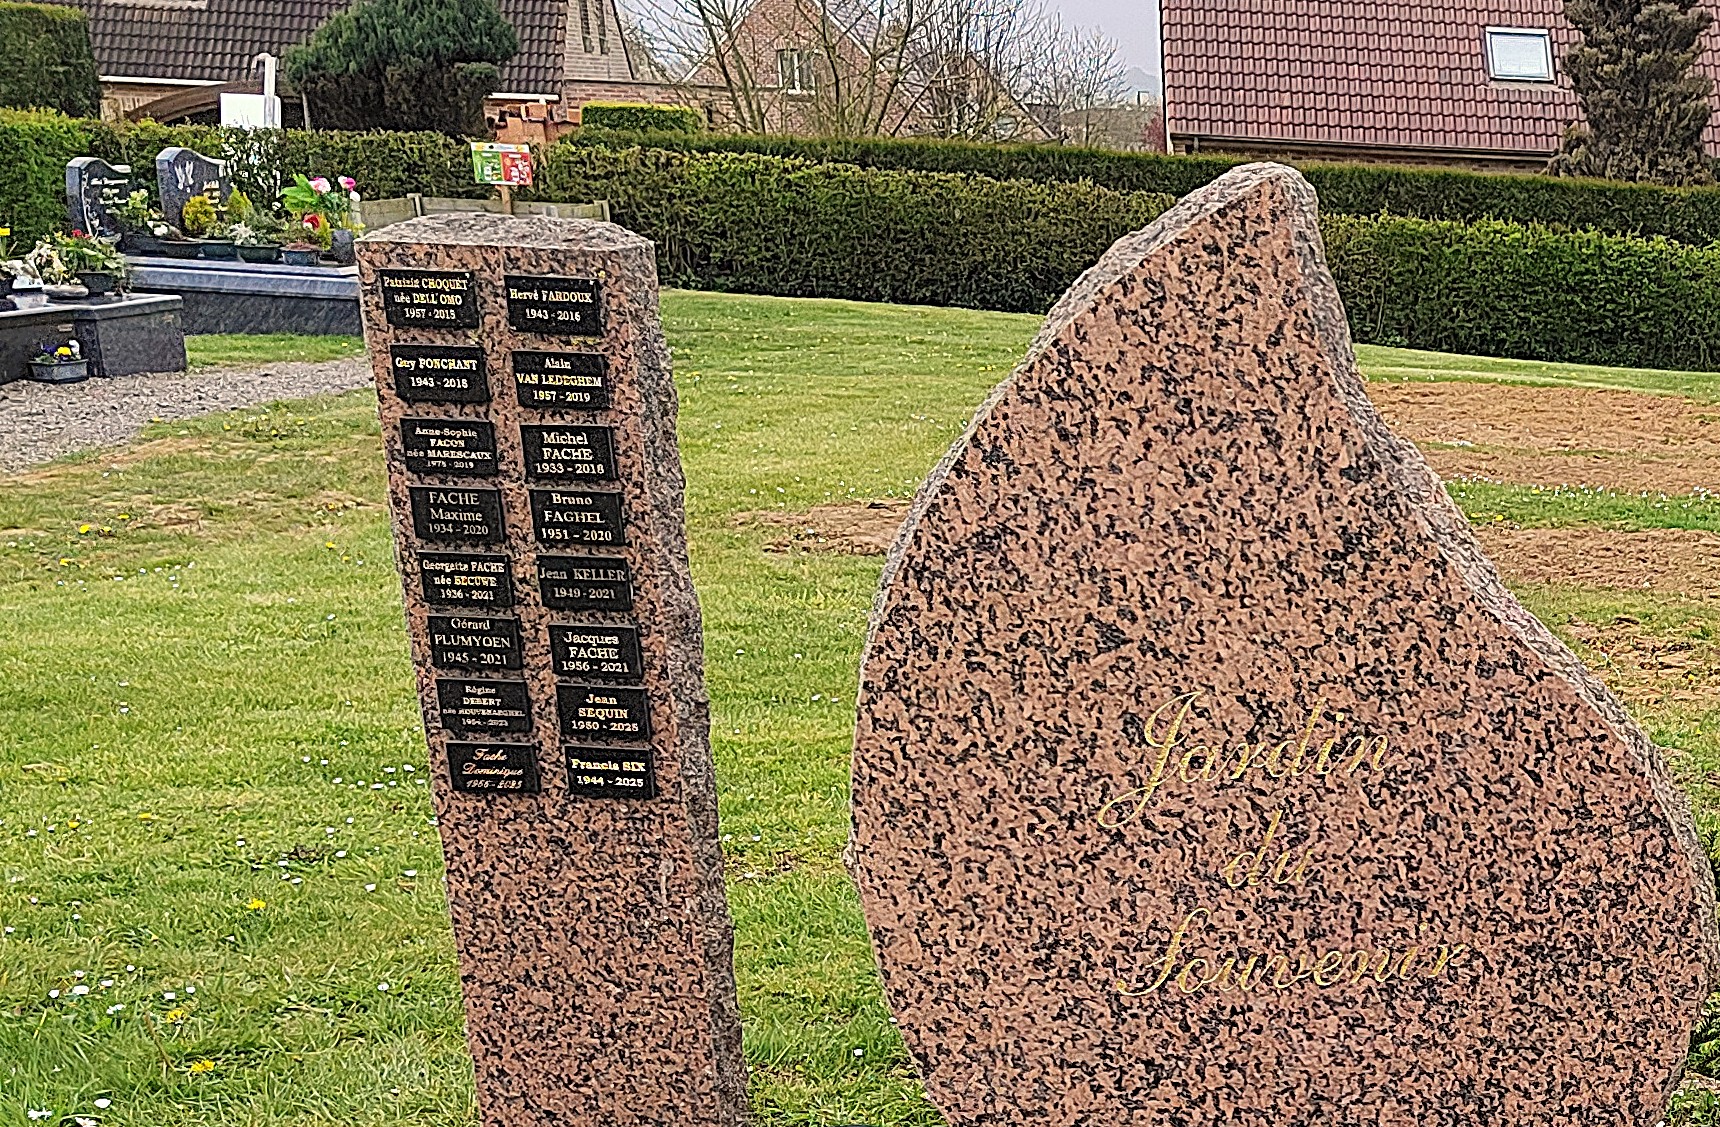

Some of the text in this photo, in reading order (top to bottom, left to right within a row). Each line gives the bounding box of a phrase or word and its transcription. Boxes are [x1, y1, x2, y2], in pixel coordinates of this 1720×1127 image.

[422, 278, 468, 291] CHOQUET
[509, 288, 593, 303] Hervé FARDOUX
[404, 308, 426, 319] 1957
[433, 309, 456, 319] 2015
[525, 308, 549, 320] 1943
[556, 311, 580, 322] 2016
[544, 357, 571, 369] Alain
[409, 376, 435, 387] 1943
[516, 373, 602, 387] VAN LEDEGHEM
[533, 390, 557, 402] 1957
[566, 392, 590, 402] 2019
[415, 427, 478, 438] Anne-Sophie
[542, 431, 588, 445] Michel
[427, 449, 492, 459] MARESCAUX
[542, 447, 593, 460] FACHE
[535, 463, 564, 473] 1933
[574, 463, 604, 474] 2018
[429, 491, 480, 505] FACHE
[551, 493, 593, 505] Bruno
[429, 508, 483, 521] Maxime
[544, 510, 605, 523] FAGHEL
[428, 523, 453, 533] 1934
[463, 525, 488, 535] 2020
[542, 528, 570, 539] 1951
[583, 530, 612, 541] 2020
[423, 560, 505, 572] Georgette FACHE
[540, 567, 627, 581] Jean KELLER
[554, 587, 581, 598] 1949
[588, 588, 615, 599] 2021
[451, 618, 491, 630] Gérard
[562, 631, 619, 646] Jacques
[443, 651, 469, 663] 1945
[480, 653, 507, 665] 2021
[568, 647, 619, 659] FACHE
[561, 661, 590, 671] 1956
[601, 662, 629, 673] 2021
[584, 693, 618, 705] Jean
[571, 759, 619, 771] Francis
[1097, 691, 1400, 828] Jardin
[462, 762, 523, 779] Dominique
[577, 776, 604, 786] 1944
[614, 778, 643, 787] 2025
[1223, 809, 1312, 888] du
[1116, 907, 1466, 997] Souvenir
